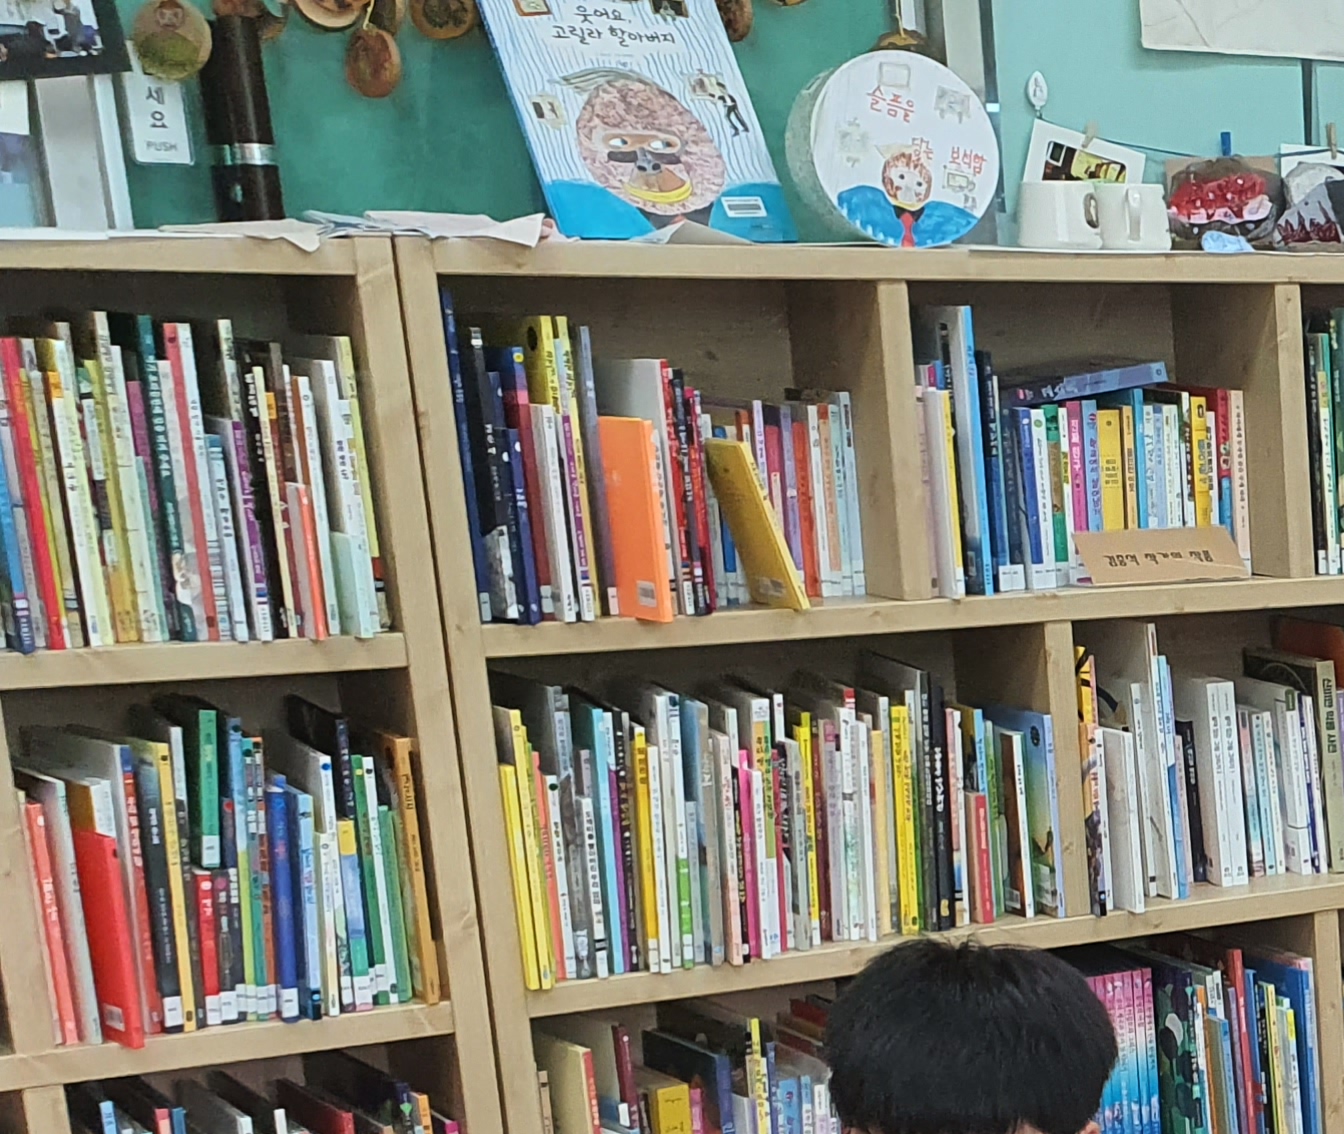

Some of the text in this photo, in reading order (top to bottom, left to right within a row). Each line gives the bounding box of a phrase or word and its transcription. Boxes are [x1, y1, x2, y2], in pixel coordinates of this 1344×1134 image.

[574, 5, 631, 24] 웃어요,
[552, 25, 675, 47] 고릴라 할아버지
[145, 86, 169, 129] 세요
[145, 140, 178, 152] PUSH
[1144, 551, 1183, 565] 작가의
[1189, 549, 1214, 562] 작품
